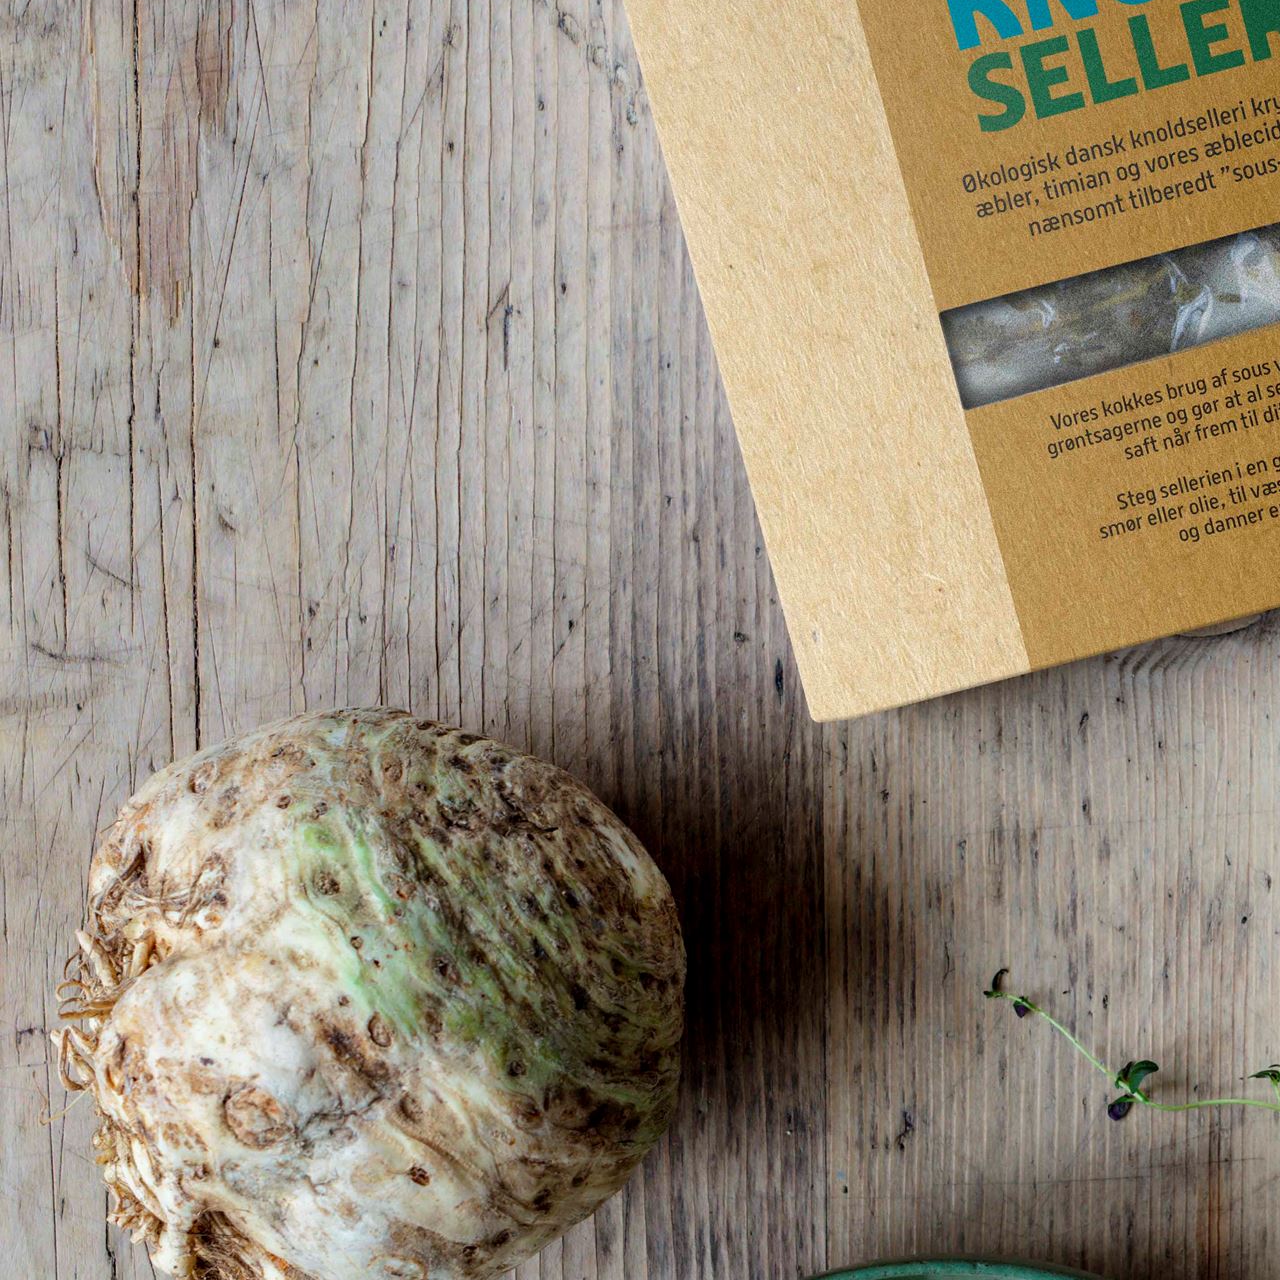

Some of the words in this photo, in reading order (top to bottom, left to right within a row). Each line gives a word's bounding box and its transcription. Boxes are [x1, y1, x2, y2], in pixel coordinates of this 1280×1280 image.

[961, 151, 1062, 194] Økologisk
[1064, 133, 1127, 166] dansk
[1128, 99, 1247, 150] knoldselleri
[975, 190, 1040, 219] æbler,
[1042, 170, 1111, 201] timian
[1115, 162, 1141, 182] og
[1143, 146, 1200, 174] vores
[1027, 194, 1126, 237] nænsomt
[1128, 169, 1217, 210] tilberedt
[1046, 414, 1162, 460] grøntsagerne
[1165, 408, 1189, 425] og
[1190, 398, 1219, 420] gør
[1224, 389, 1243, 409] at
[1246, 383, 1263, 404] al
[1049, 407, 1099, 431] Vores
[1100, 389, 1164, 418] kokkes
[1164, 378, 1208, 400] brug
[1211, 367, 1228, 389] af
[1231, 361, 1272, 384] sous
[1123, 435, 1159, 461] saft
[1162, 426, 1191, 450] når
[1193, 419, 1238, 442] frem
[1239, 408, 1259, 430] til
[1098, 516, 1143, 540] smør
[1146, 504, 1184, 527] eller
[1188, 494, 1226, 516] olie,
[1228, 484, 1248, 505] til
[1116, 488, 1157, 511] Steg
[1159, 468, 1234, 499] sellerien
[1234, 462, 1243, 479] i
[1245, 459, 1269, 477] en
[1178, 525, 1201, 543] og
[1203, 507, 1264, 536] danner
